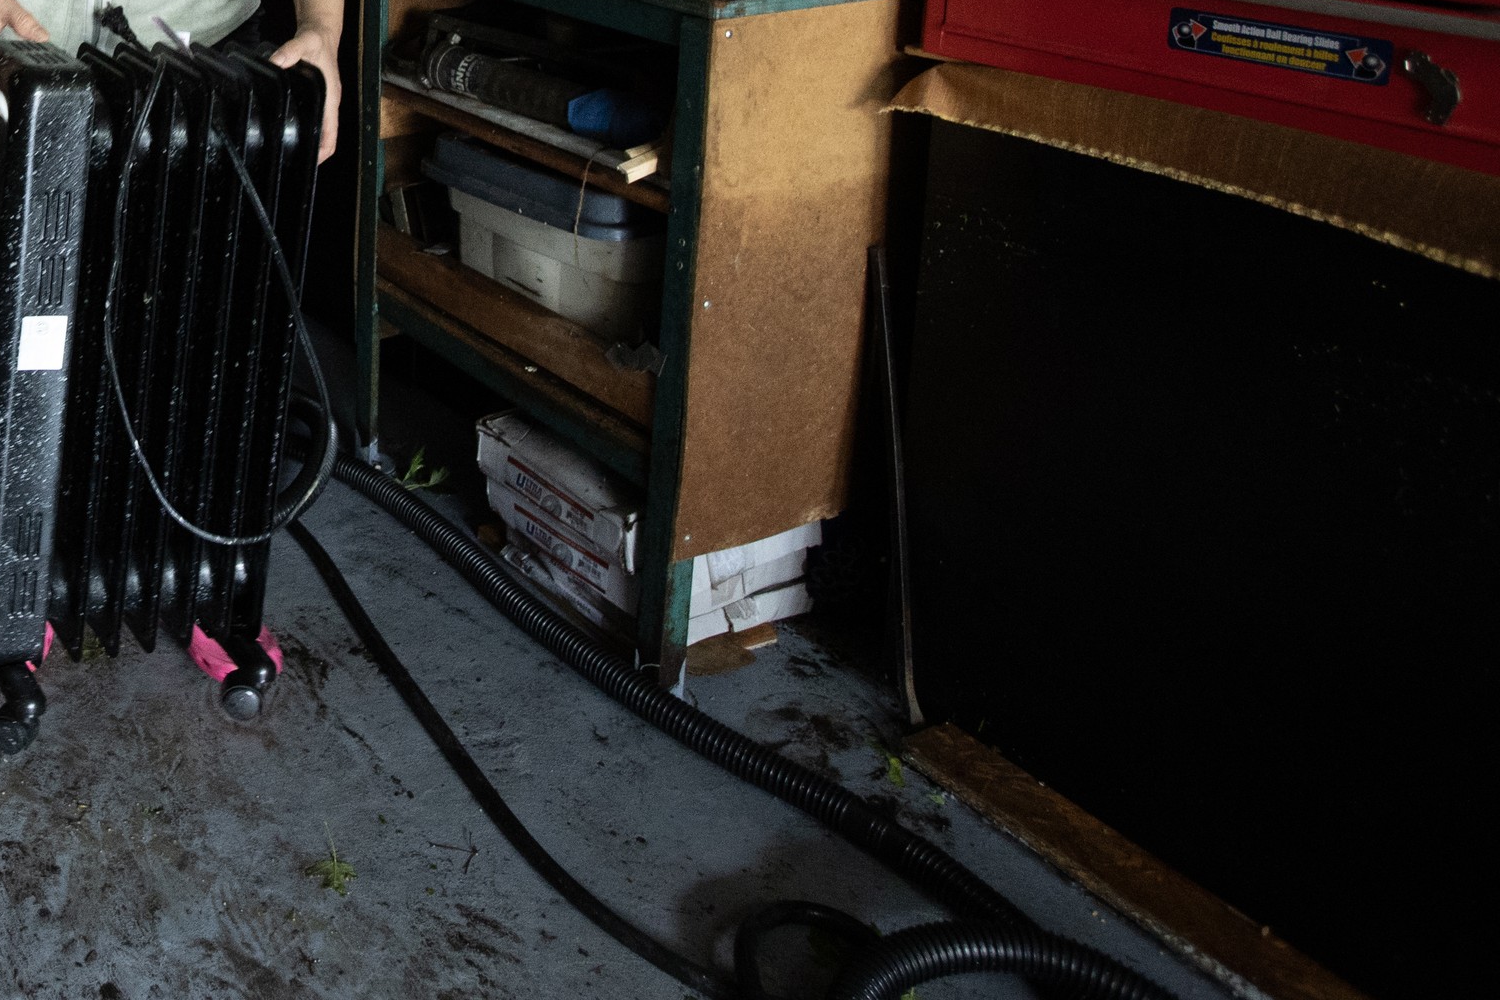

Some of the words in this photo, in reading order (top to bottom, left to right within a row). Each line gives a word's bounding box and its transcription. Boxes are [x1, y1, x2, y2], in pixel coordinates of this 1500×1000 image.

[1213, 20, 1240, 33] Smooth
[1241, 24, 1265, 37] Action
[1266, 28, 1281, 40] Ball
[1282, 31, 1313, 47] Bearing
[1313, 36, 1340, 50] Slides
[516, 473, 543, 497] ULTRA
[526, 520, 553, 544] ULTRA
